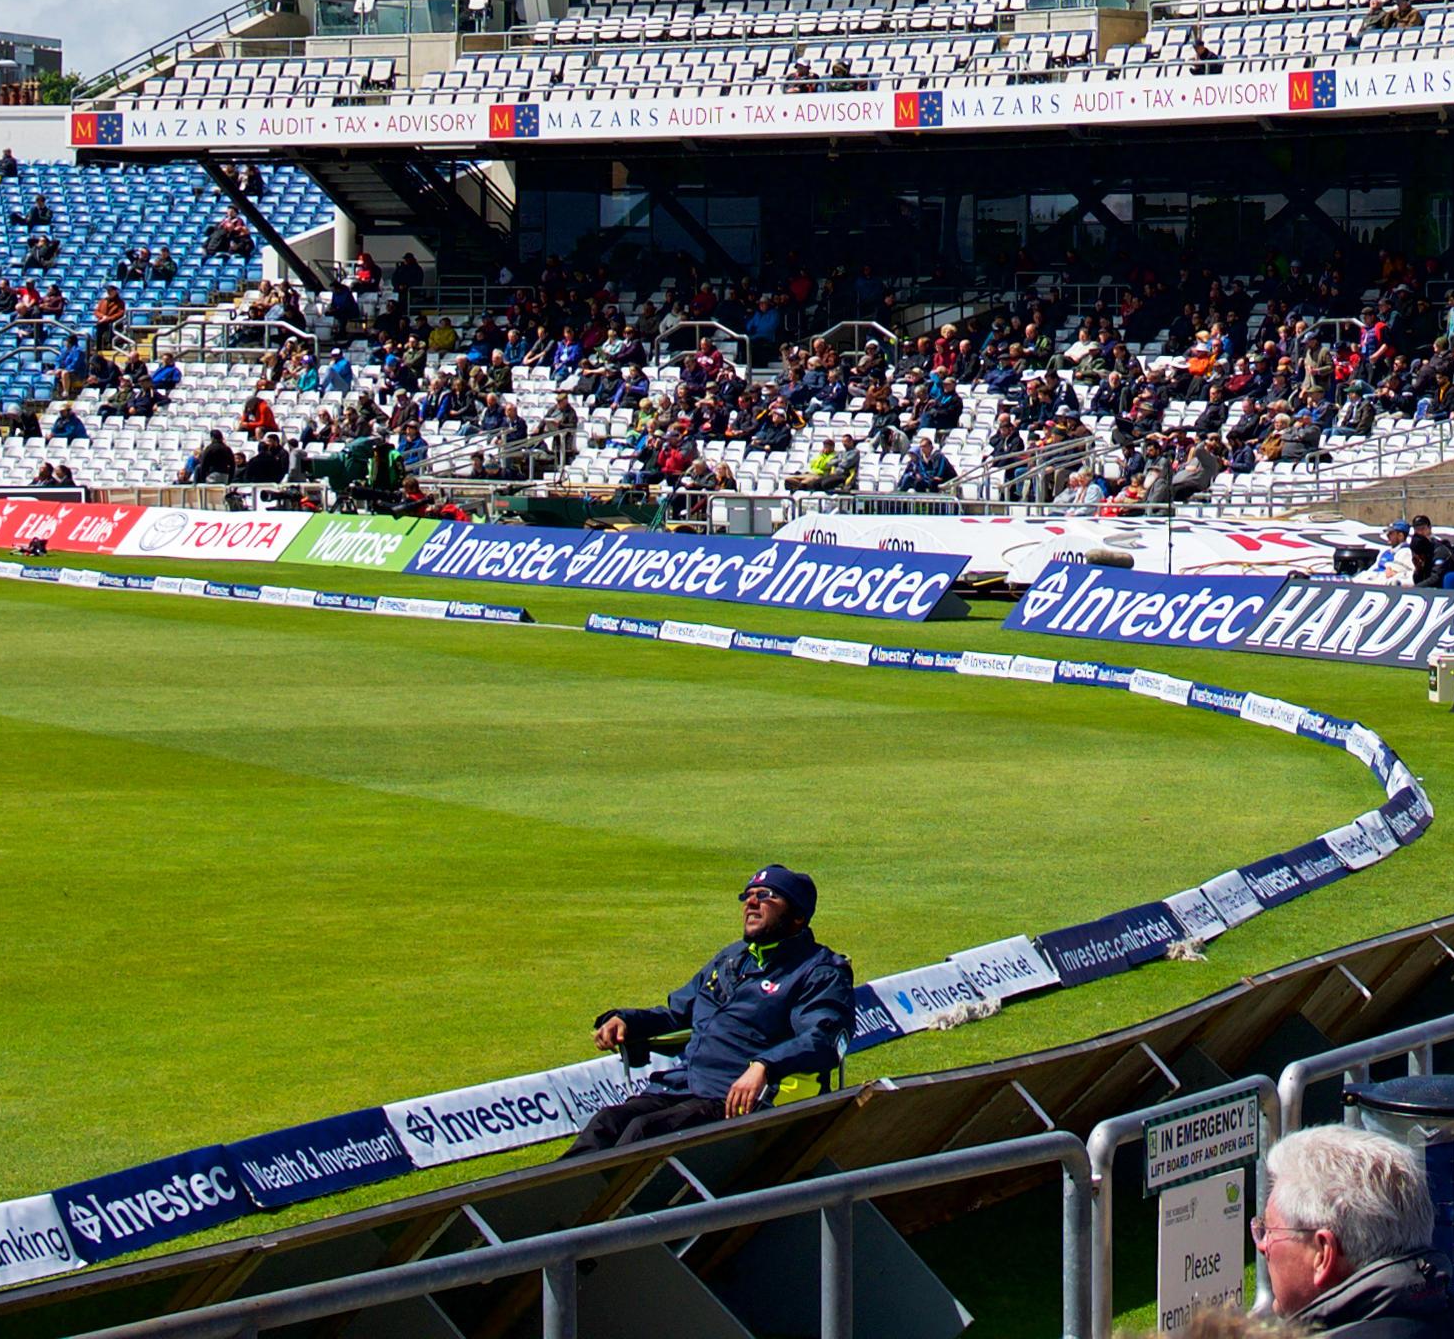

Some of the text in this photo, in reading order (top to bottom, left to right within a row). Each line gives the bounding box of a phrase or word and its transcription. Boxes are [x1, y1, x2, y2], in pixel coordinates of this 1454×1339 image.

[950, 94, 1060, 117] MAZARS
[1073, 91, 1124, 113] AUDIT
[1143, 88, 1175, 108] TAX
[1193, 83, 1278, 107] ADVISORY
[1344, 70, 1452, 98] MAZARS
[131, 118, 246, 137] MAZARS
[259, 117, 315, 136] AUDIT
[335, 116, 368, 133] TAX
[387, 114, 478, 133] ADVISORY
[547, 108, 659, 129] MAZARS
[668, 106, 724, 126] AUDIT
[744, 105, 775, 123] TAX
[794, 102, 885, 122] ADVISORY
[183, 521, 283, 549] TOYOTA
[306, 520, 403, 567] Waitrose
[435, 525, 574, 582] Investec
[581, 533, 742, 595] Investec
[759, 544, 949, 616] Investec
[1049, 569, 1266, 645] Investec
[428, 1091, 559, 1144] Investec
[1161, 1106, 1245, 1153] IN EMERGENCY
[1150, 1133, 1254, 1179] LIFT BOARD OFF AND OPEN GATE
[89, 1127, 402, 1240] Investec Wealth & Investment
[1185, 1252, 1221, 1283] Please
